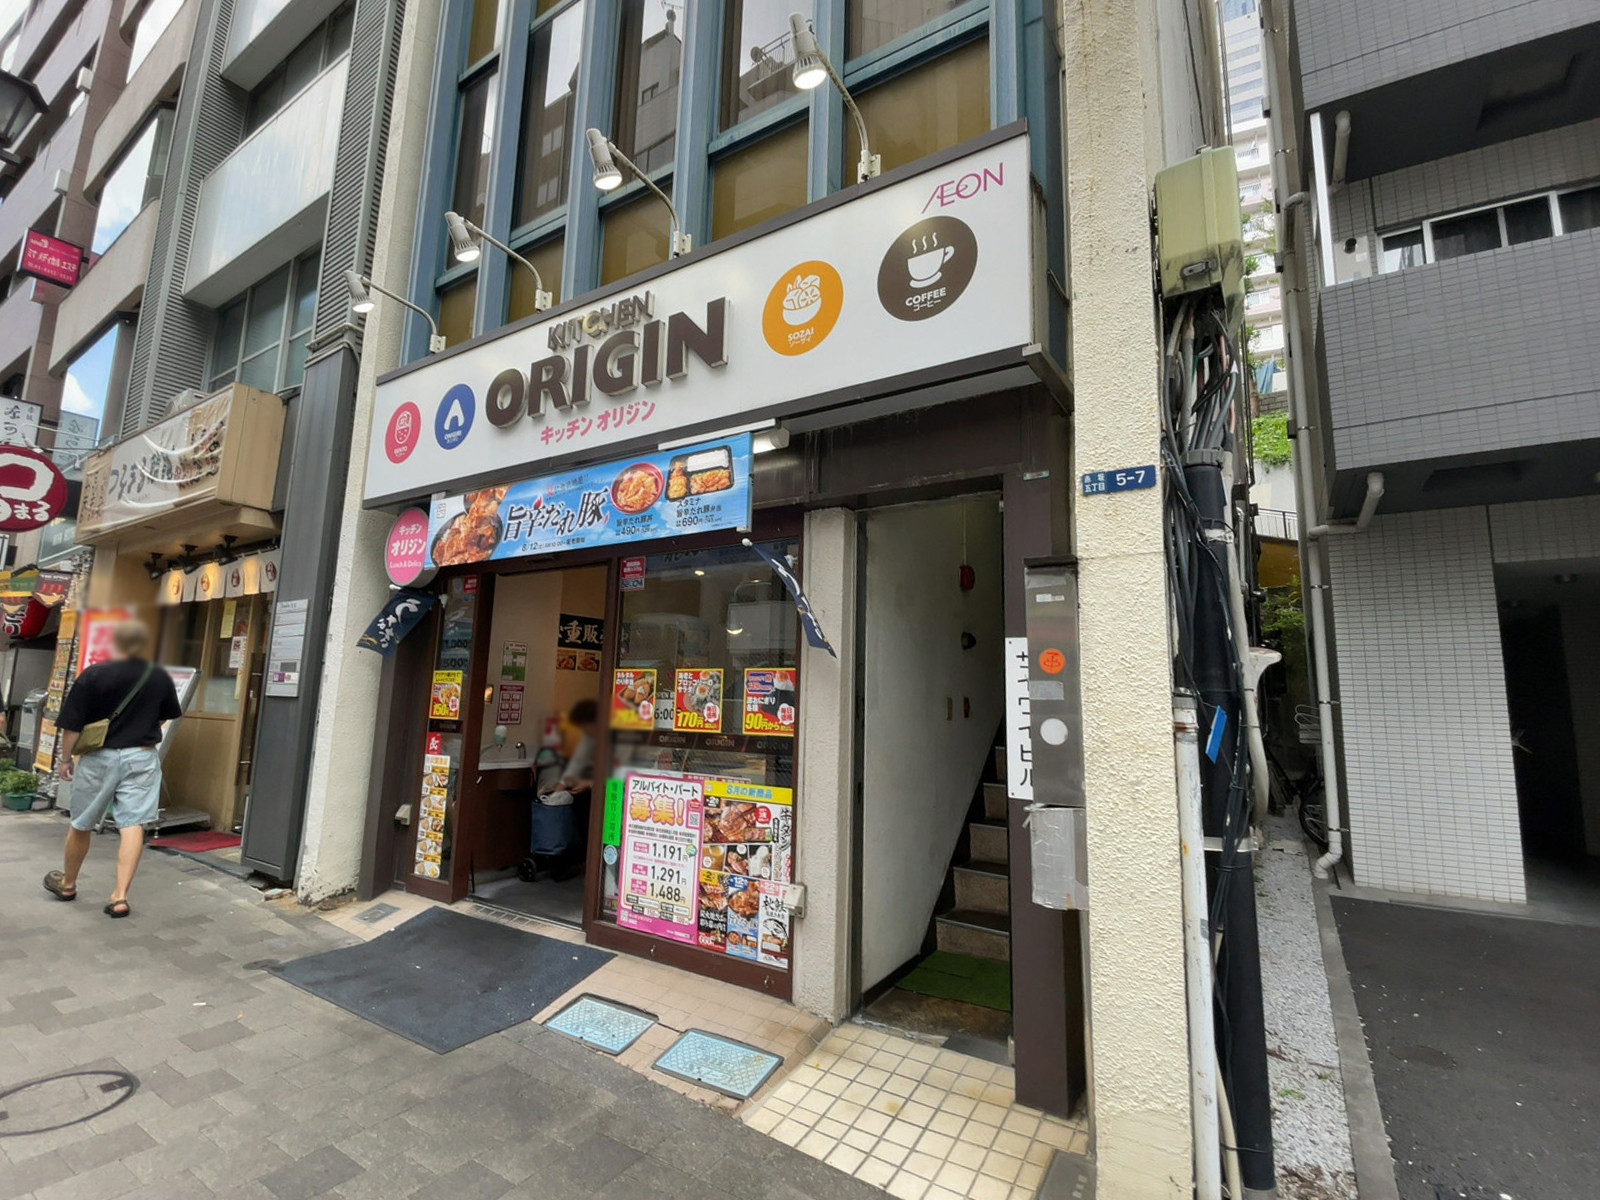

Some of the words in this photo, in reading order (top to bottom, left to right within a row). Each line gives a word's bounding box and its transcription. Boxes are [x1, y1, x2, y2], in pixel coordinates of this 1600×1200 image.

[905, 287, 947, 306] COFFEE
[913, 299, 942, 312] コーヒー
[547, 290, 656, 351] KITCHEN
[787, 328, 815, 342] SOZAI
[485, 297, 732, 428] ORIGIN
[1084, 472, 1105, 483] 赤坂
[1116, 470, 1145, 486] 5-7
[1084, 483, 1106, 493] 五丁目
[677, 497, 701, 508] スタミナ
[504, 488, 609, 541] 旨辛だれ豚
[398, 523, 422, 535] キッチン
[391, 538, 427, 556] オリジン
[677, 711, 704, 728] 170円
[745, 713, 780, 730] 90円から
[631, 780, 699, 798] アルバイト・パート
[629, 792, 684, 827] 募集!
